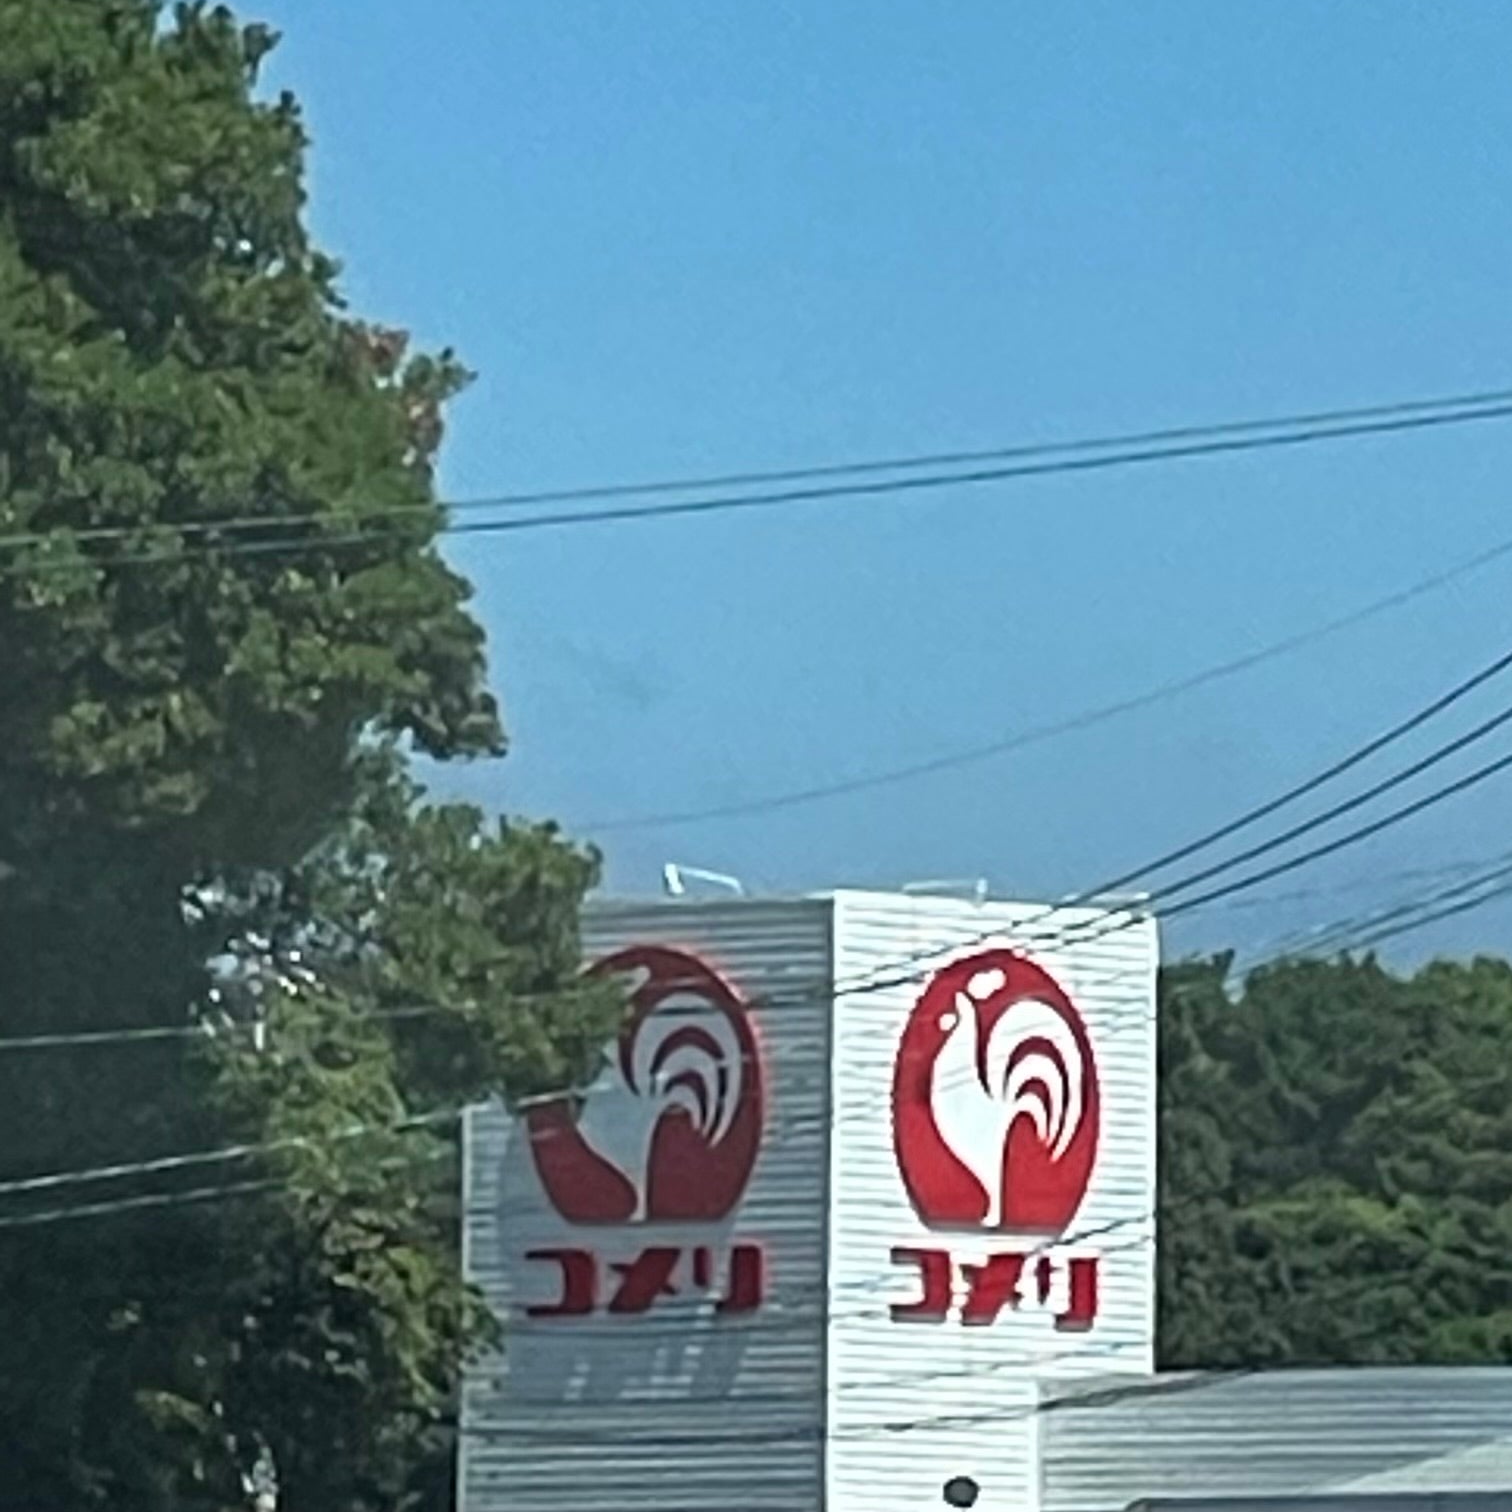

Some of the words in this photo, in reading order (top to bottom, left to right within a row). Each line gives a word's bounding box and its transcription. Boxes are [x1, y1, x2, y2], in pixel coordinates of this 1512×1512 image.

[524, 1246, 764, 1317] コメリ
[890, 1247, 1100, 1331] コメリ
